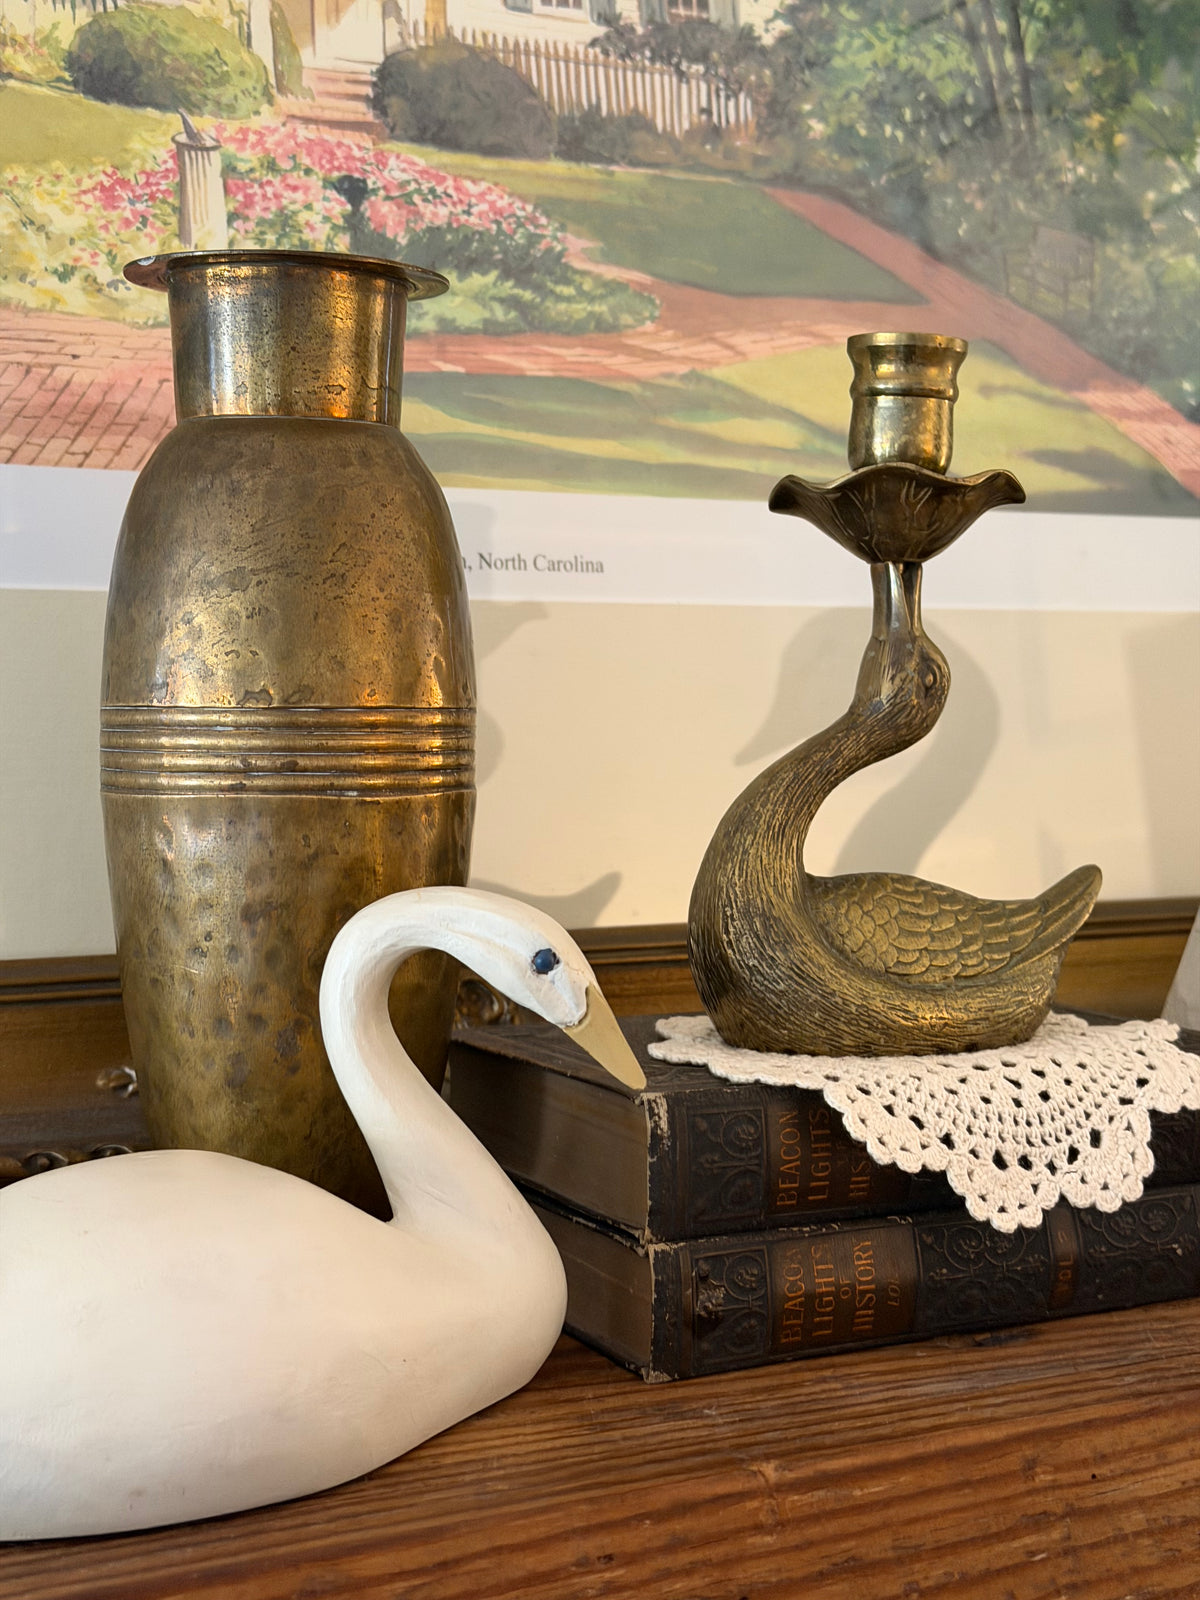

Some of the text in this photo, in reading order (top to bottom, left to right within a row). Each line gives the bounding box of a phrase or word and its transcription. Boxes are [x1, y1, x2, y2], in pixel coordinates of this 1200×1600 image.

[477, 552, 528, 571] North
[532, 554, 605, 574] Carolina
[776, 1109, 801, 1207] BEACON
[807, 1107, 832, 1201] LIGHTS
[811, 1243, 836, 1337] LIGHTS
[838, 1272, 852, 1300] OF
[852, 1240, 877, 1333] HISTORY
